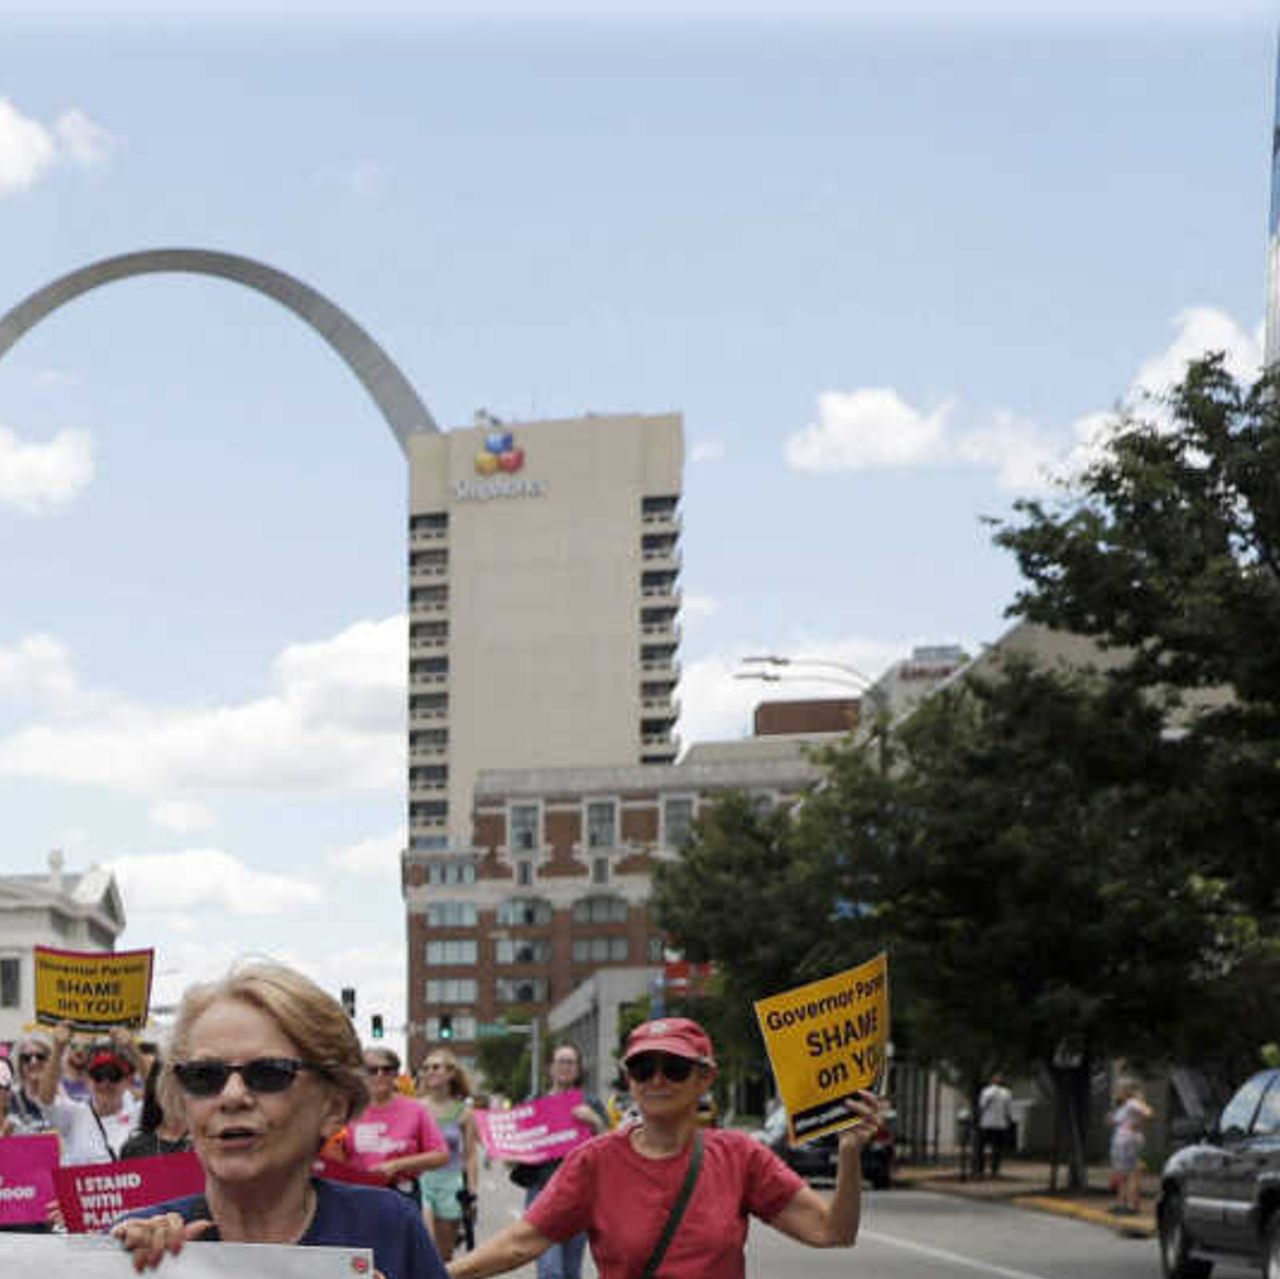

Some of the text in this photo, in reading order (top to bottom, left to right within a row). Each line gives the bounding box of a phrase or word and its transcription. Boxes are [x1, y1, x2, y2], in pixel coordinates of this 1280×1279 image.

[56, 979, 123, 997] SHAME
[82, 999, 125, 1014] YOU
[766, 988, 854, 1031] Governor
[805, 1005, 879, 1057] SHAME
[817, 1061, 849, 1090] on
[84, 1173, 142, 1194] STAND
[80, 1192, 124, 1210] WITH
